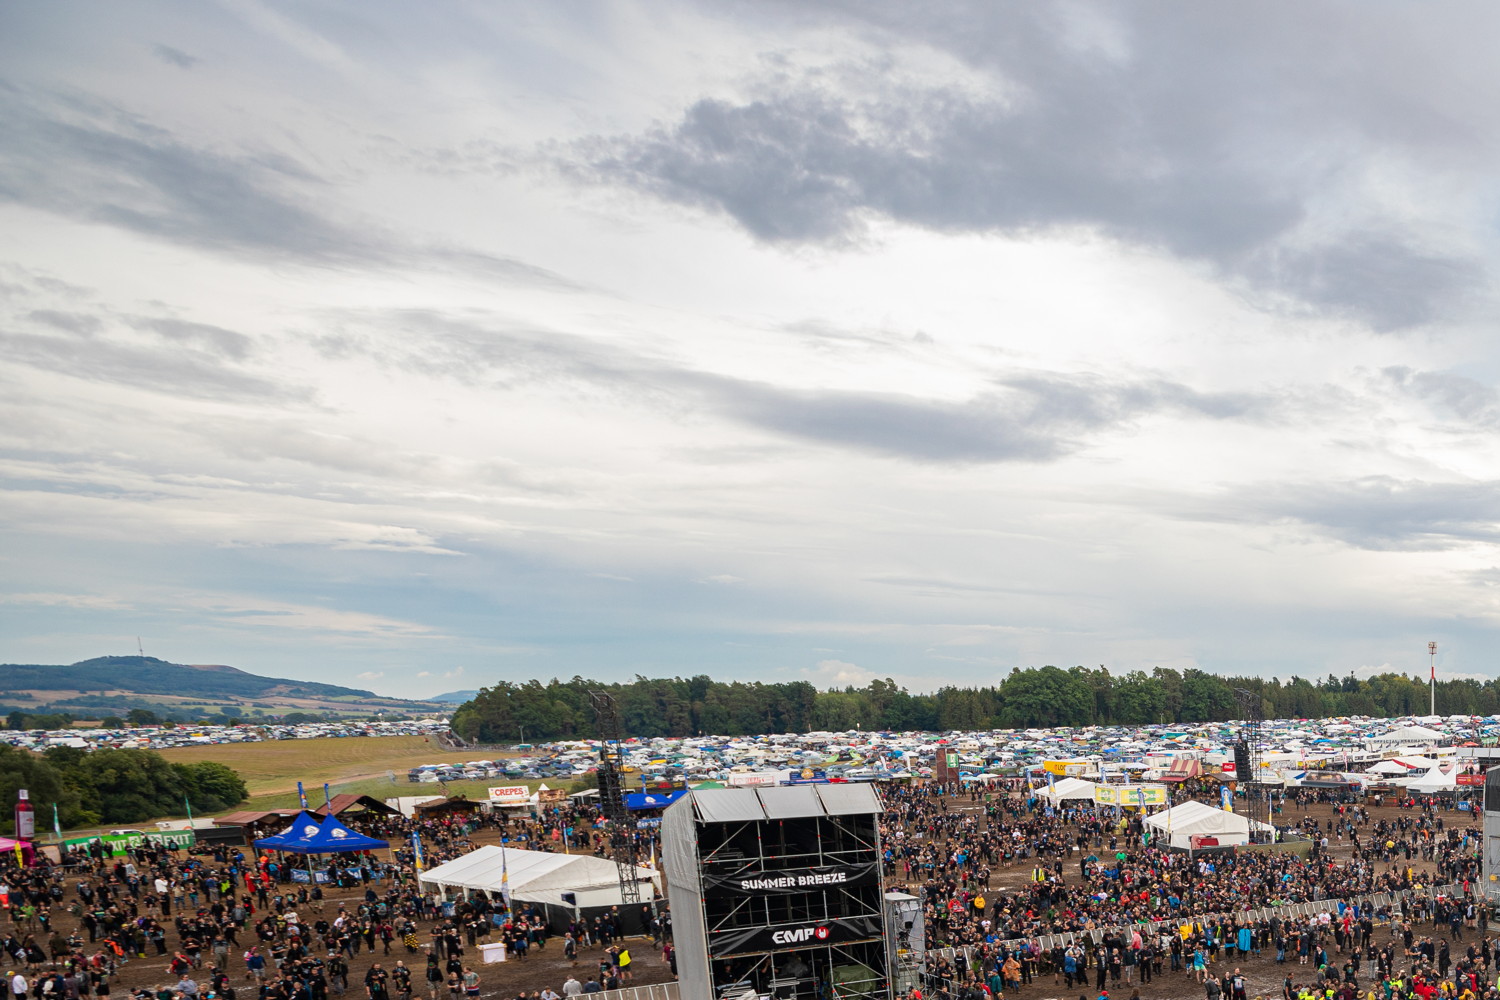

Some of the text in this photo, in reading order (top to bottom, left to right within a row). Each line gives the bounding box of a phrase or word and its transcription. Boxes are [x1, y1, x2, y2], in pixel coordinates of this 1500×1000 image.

[495, 788, 523, 796] CREPES
[741, 872, 847, 890] SUMMER BREEZE
[772, 927, 815, 944] EMP
